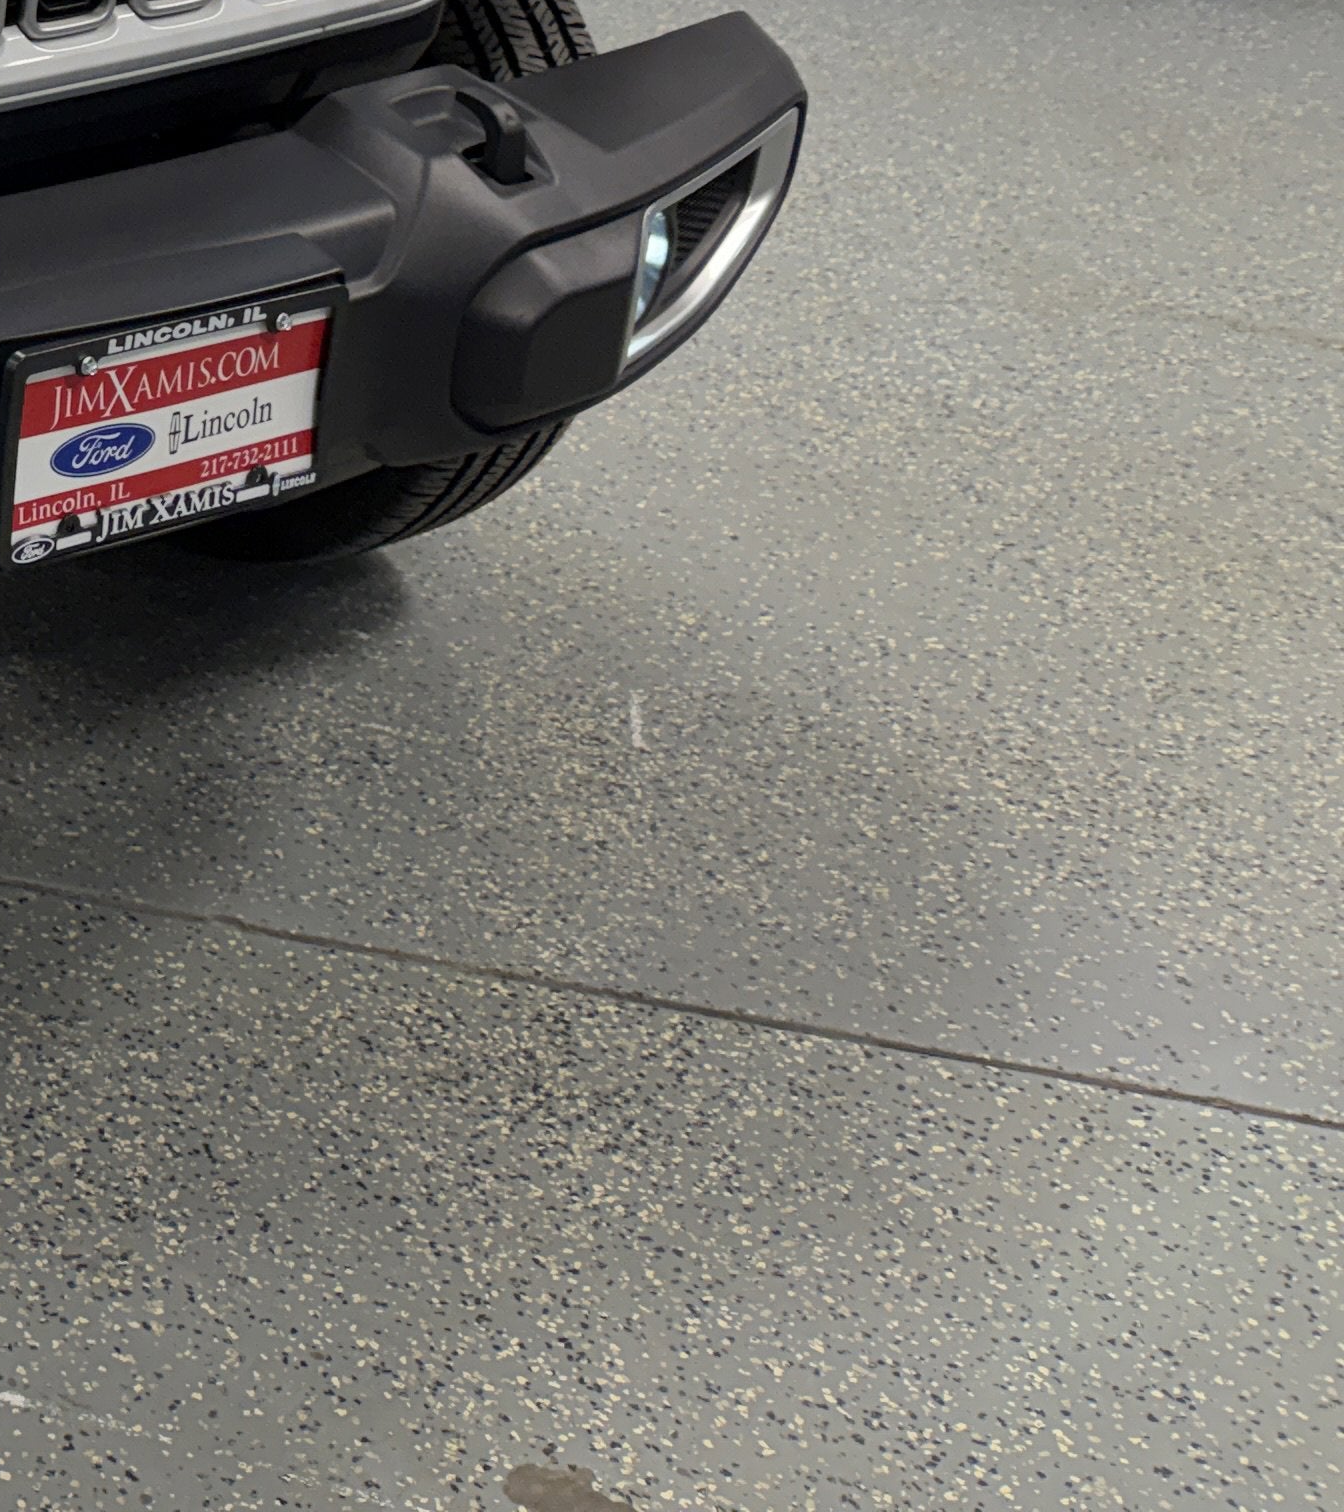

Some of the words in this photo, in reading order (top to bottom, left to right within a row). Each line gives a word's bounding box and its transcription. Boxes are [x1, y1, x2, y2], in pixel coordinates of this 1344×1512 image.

[107, 313, 235, 355] LINCOLN,
[242, 306, 267, 324] IL
[49, 342, 281, 431] JIMXAMIS.COM
[180, 397, 273, 445] Lincoln
[72, 432, 135, 470] Ford
[200, 437, 298, 478] 217-732-2111
[18, 489, 102, 526] Lincoln,
[110, 482, 130, 503] IL
[96, 506, 145, 542] JIM
[149, 487, 235, 523] XAMIS
[21, 543, 46, 561] Ford
